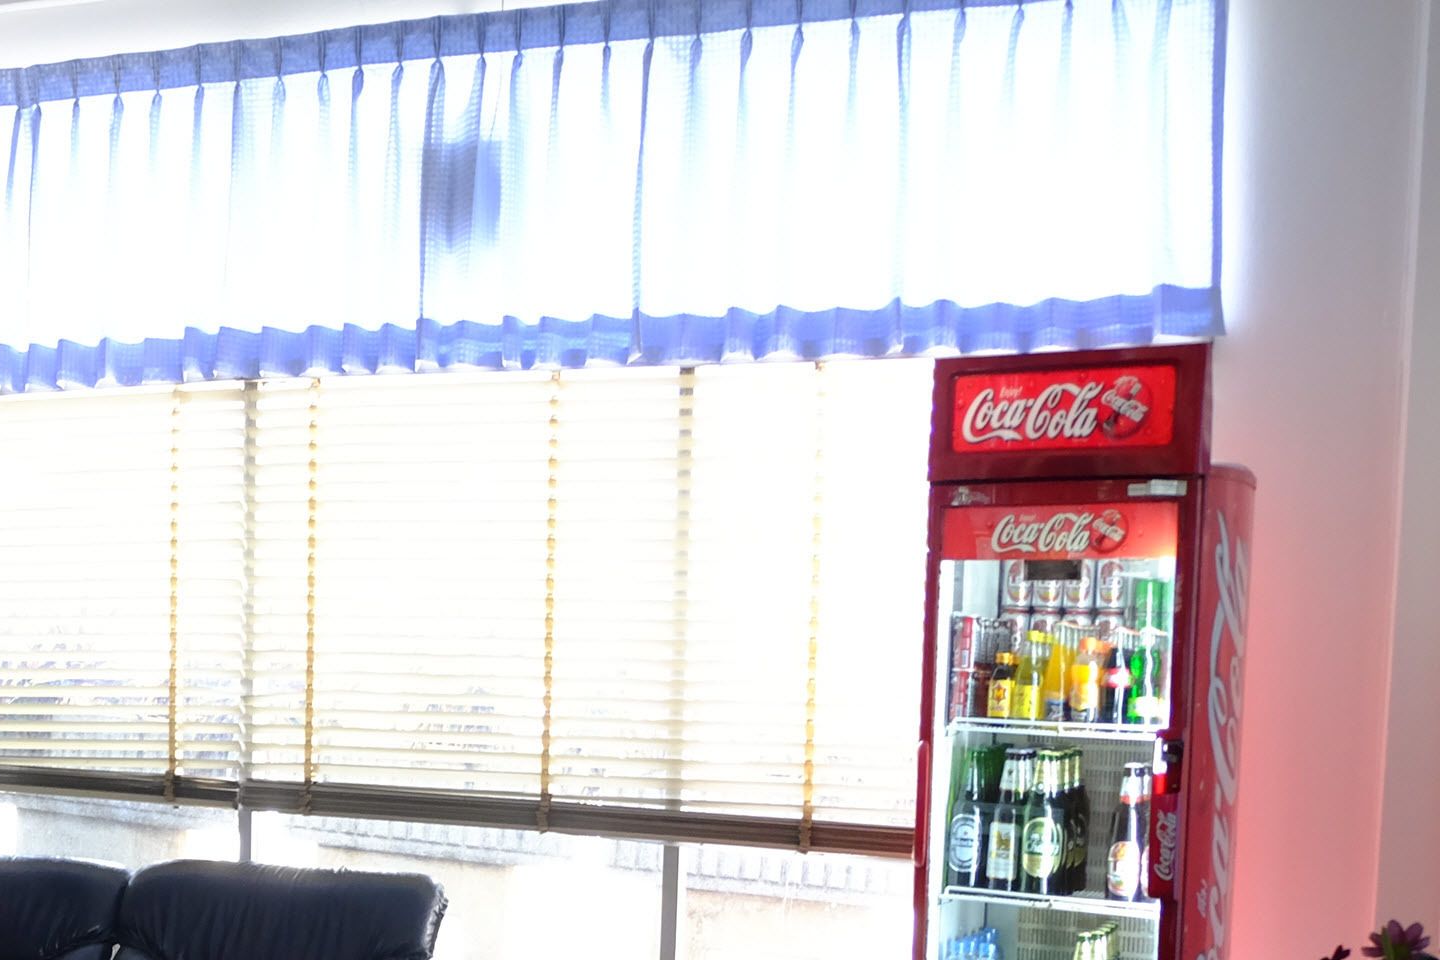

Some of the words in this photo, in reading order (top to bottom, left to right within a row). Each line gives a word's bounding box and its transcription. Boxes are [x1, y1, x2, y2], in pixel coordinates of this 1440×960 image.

[961, 380, 1105, 444] Coca-Cola
[991, 511, 1095, 554] Coca-Cola
[1153, 809, 1177, 881] Coca-Cola
